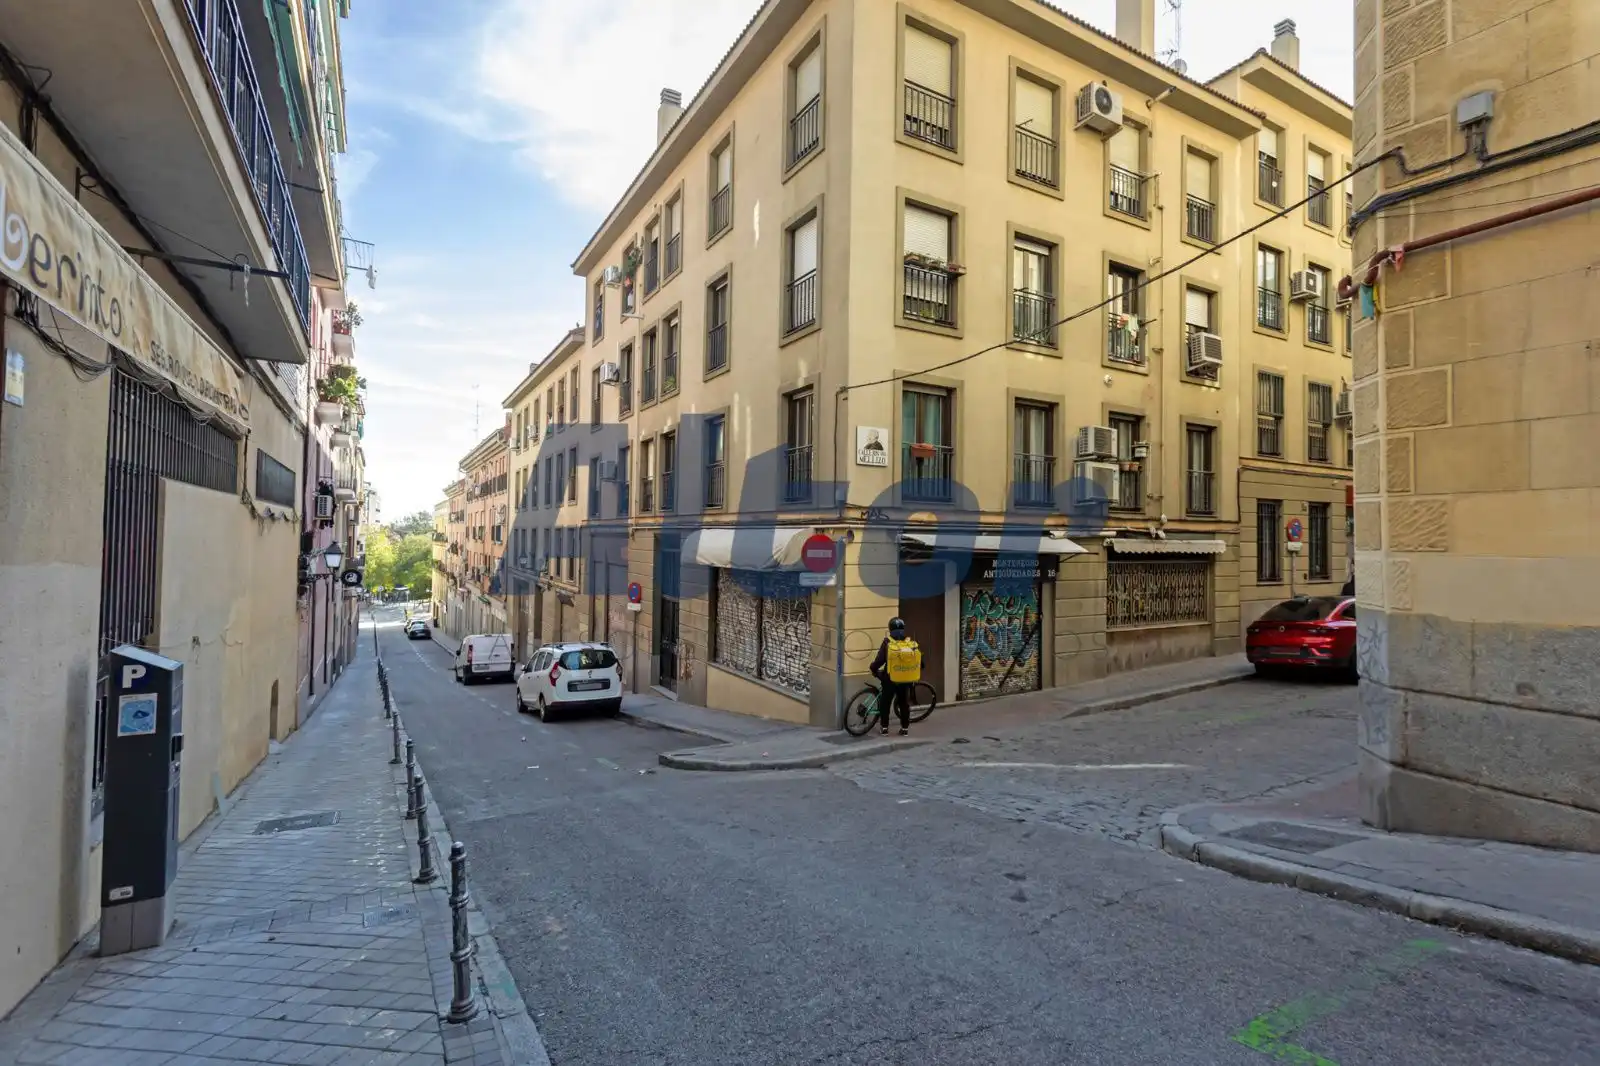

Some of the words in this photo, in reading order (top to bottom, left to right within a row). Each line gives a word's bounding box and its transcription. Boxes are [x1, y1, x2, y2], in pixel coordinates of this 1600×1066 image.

[860, 455, 886, 465] MELLIZO
[1047, 569, 1056, 577] 16
[122, 664, 147, 689] P
